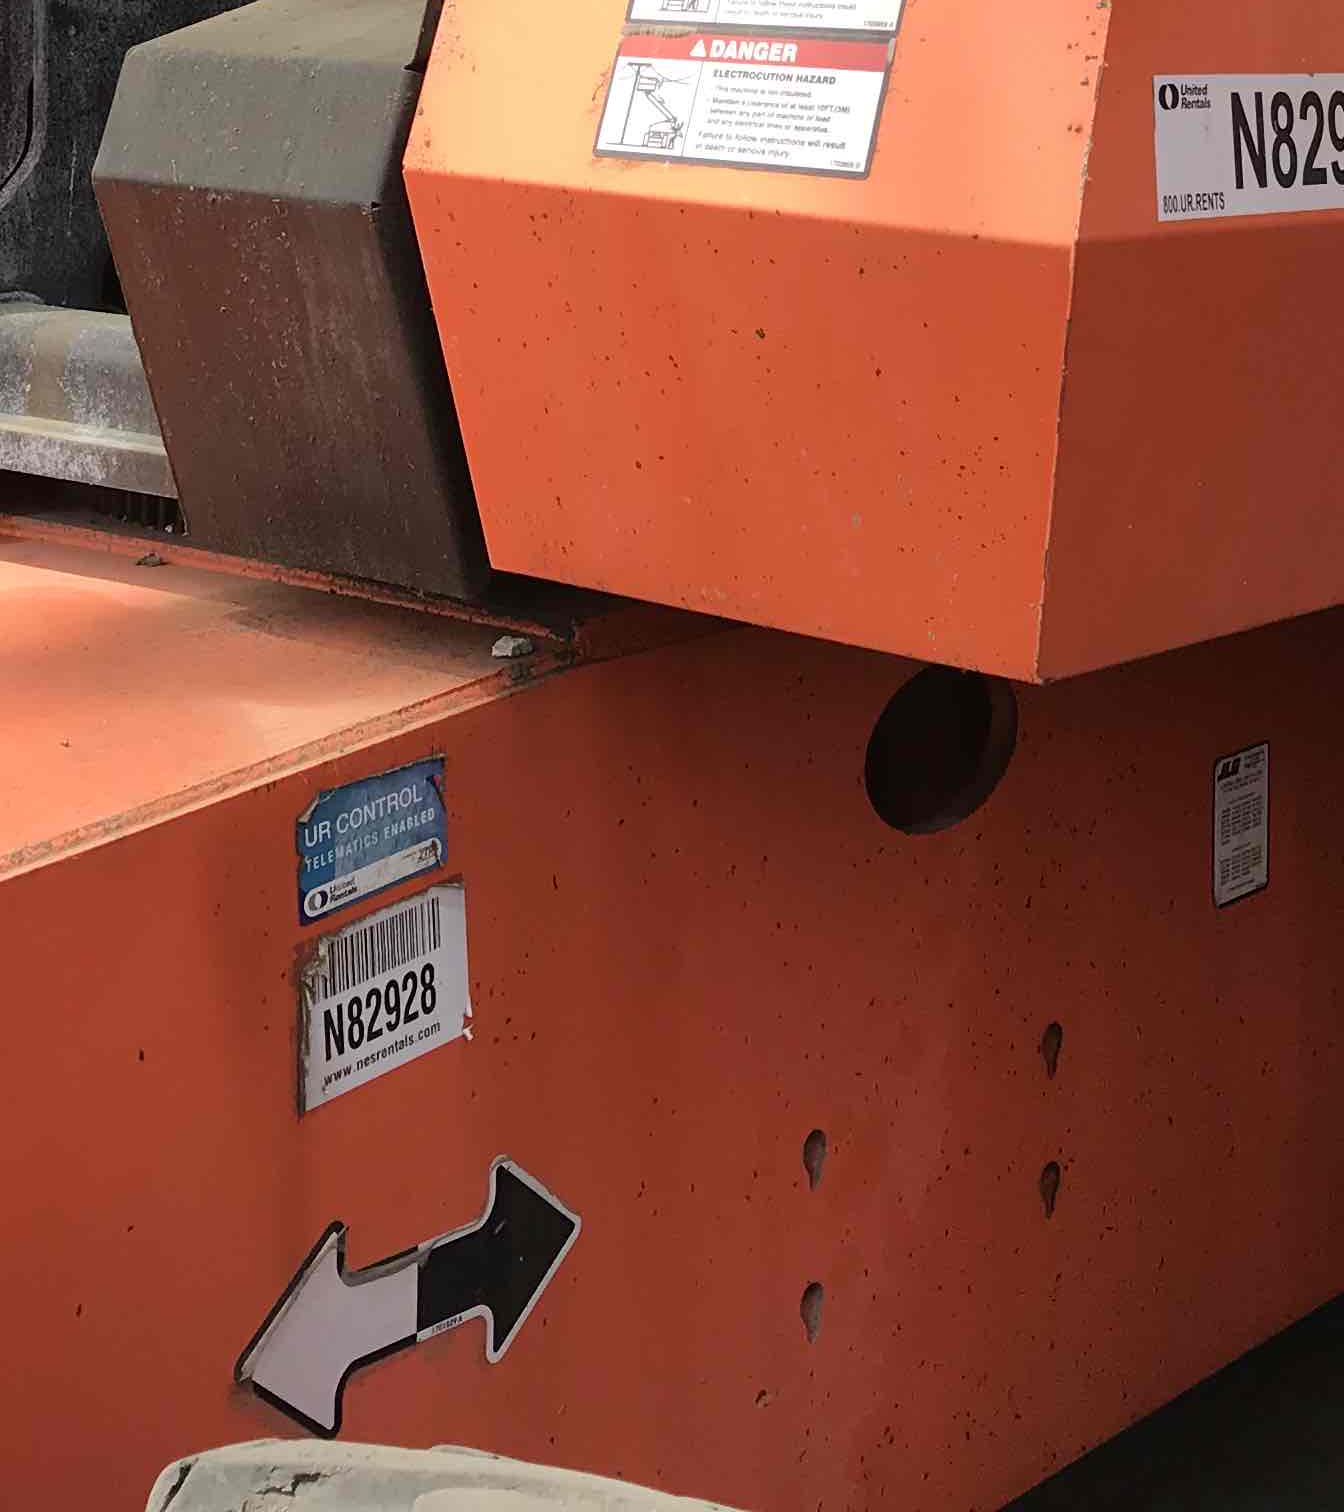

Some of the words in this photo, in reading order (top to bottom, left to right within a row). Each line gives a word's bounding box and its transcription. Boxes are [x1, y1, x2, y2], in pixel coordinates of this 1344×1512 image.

[709, 39, 799, 63] DANGER
[713, 69, 794, 83] ELECTROCUTION
[795, 75, 837, 86] HAZARD
[1180, 84, 1208, 96] United
[1181, 97, 1212, 109] Rentals
[1162, 192, 1226, 215] 800.UR.RENTS
[304, 820, 331, 847] UR
[336, 784, 423, 834] CONTROL
[304, 831, 379, 873] TELEMATICS
[383, 807, 435, 840] ENABLED
[323, 962, 437, 1064] N82928
[322, 1019, 442, 1090] www.nesrentals.com
